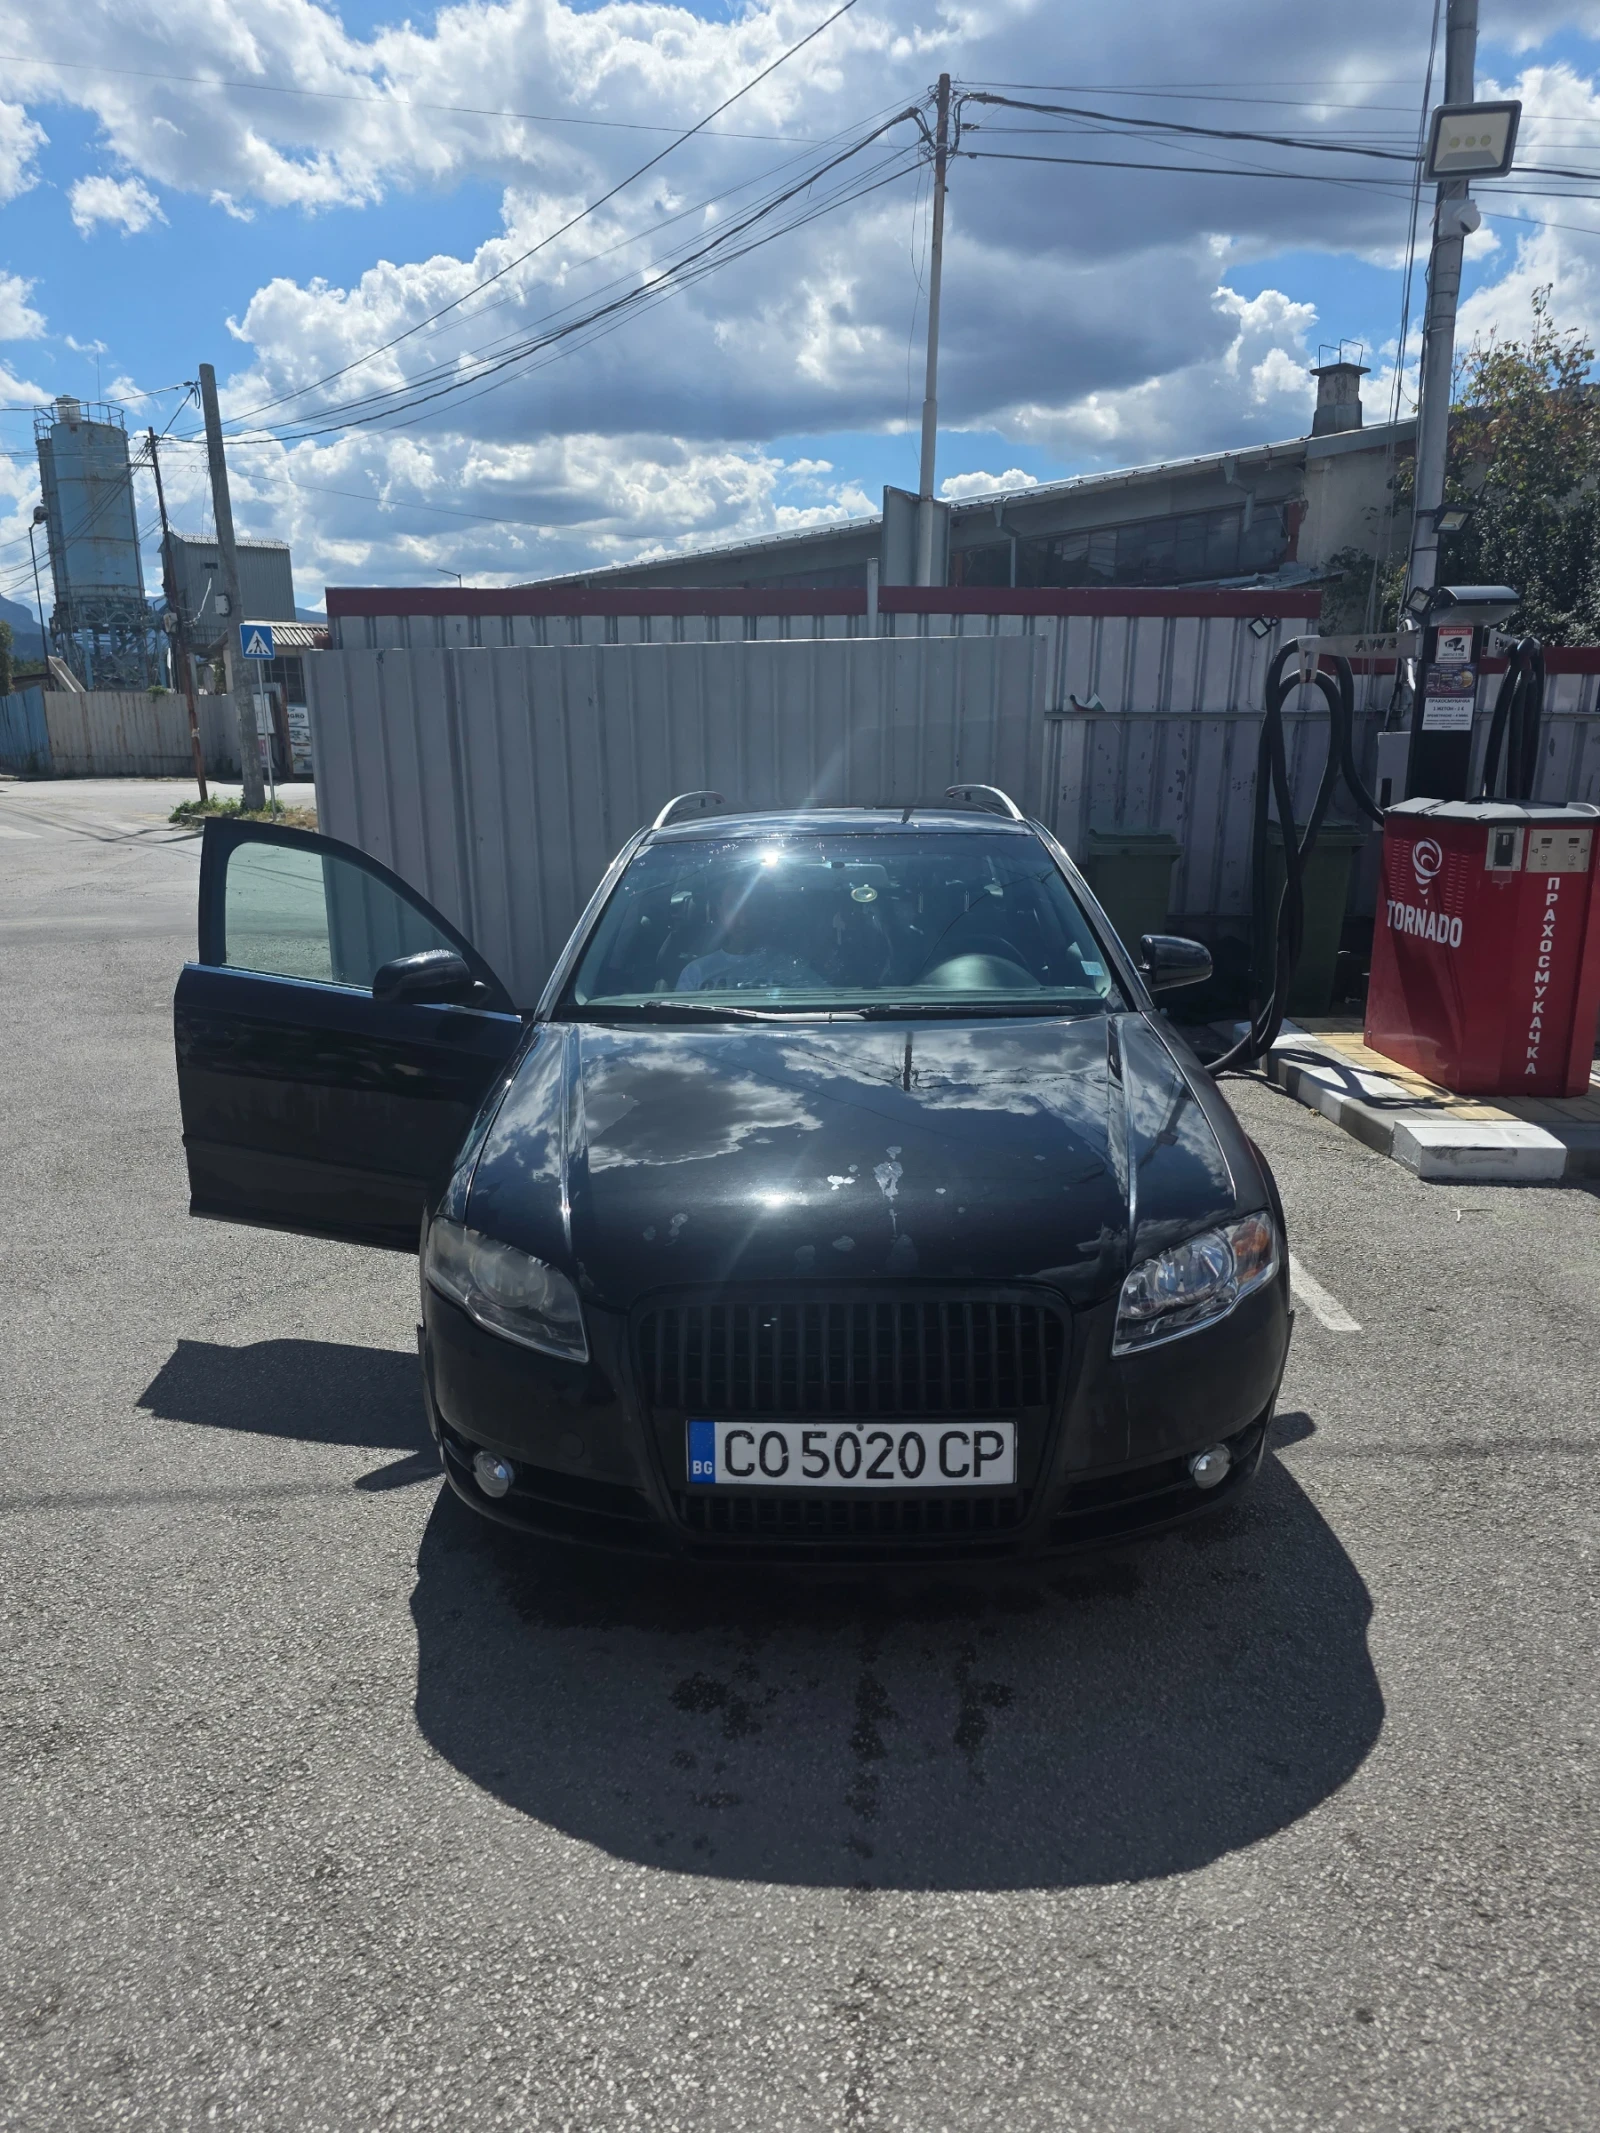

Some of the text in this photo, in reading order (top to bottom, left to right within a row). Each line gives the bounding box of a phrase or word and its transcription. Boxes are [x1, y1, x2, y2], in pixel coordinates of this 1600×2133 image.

[1387, 899, 1463, 948] TORNADO
[1524, 877, 1560, 1075] ПРАХОСМУКАЧКА
[692, 1429, 1004, 1479] BG CO 5020 CP
